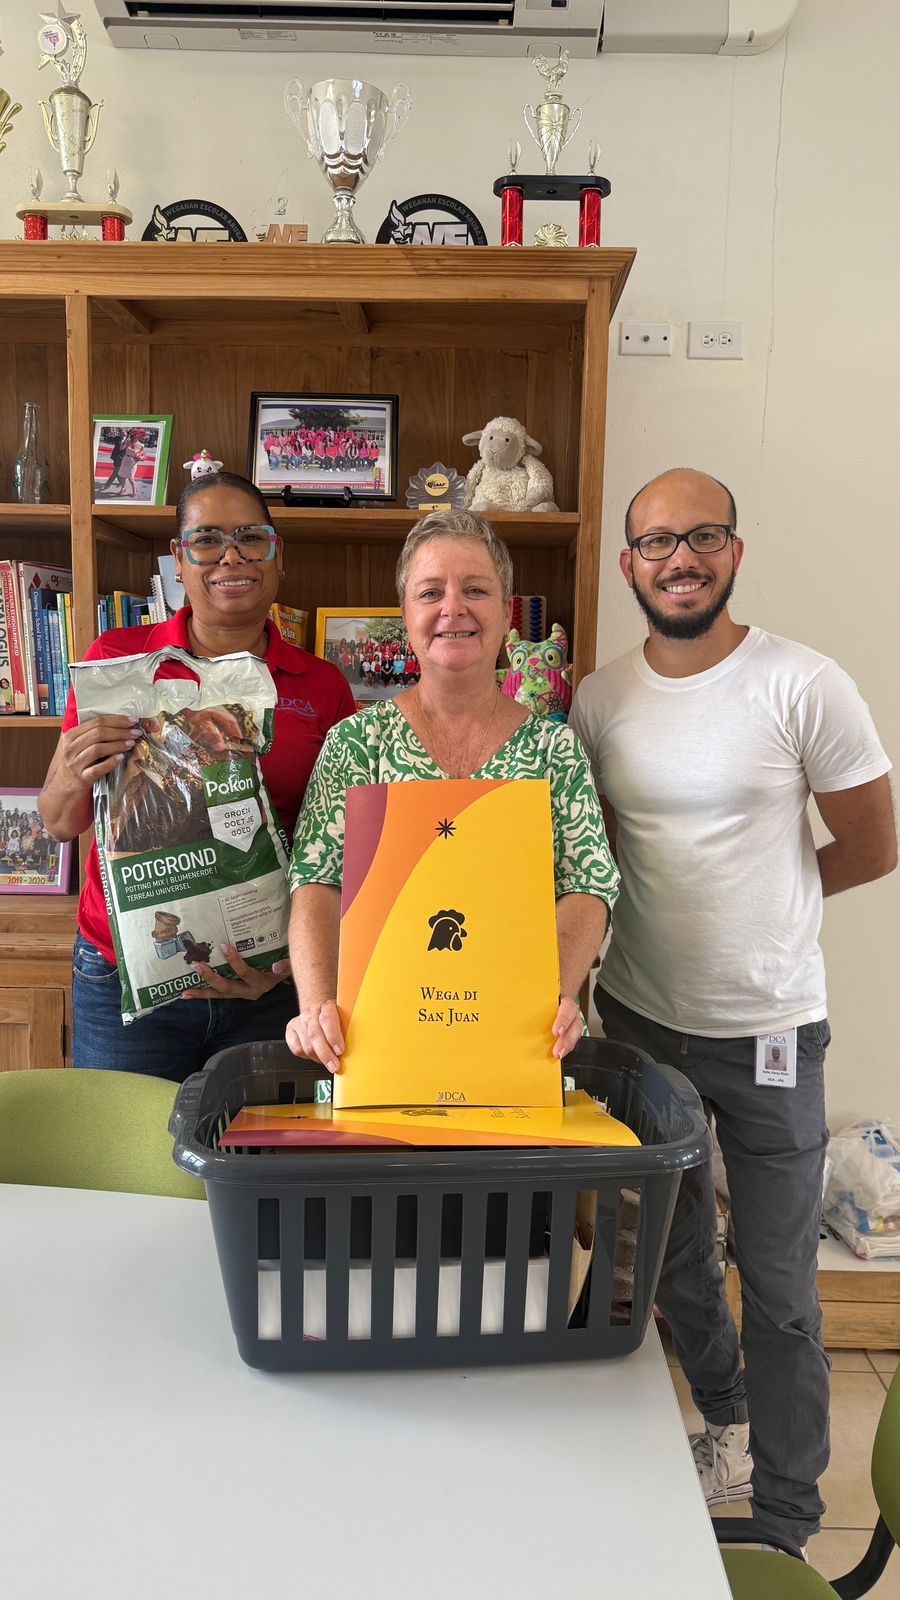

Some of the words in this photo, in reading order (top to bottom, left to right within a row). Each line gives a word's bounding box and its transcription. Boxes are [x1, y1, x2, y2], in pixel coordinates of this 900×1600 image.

[165, 203, 198, 217] WEGANAN
[200, 203, 226, 221] ESCOLAR
[275, 197, 288, 216] 2
[401, 198, 436, 212] WEGANAN
[438, 198, 466, 217] ESCOLAR
[280, 697, 315, 713] DCA
[205, 777, 254, 797] Pokon
[224, 807, 251, 819] GROEN
[224, 818, 245, 829] DOET
[246, 816, 254, 824] JE
[231, 826, 251, 836] GOED
[120, 848, 217, 884] POTGROND
[125, 881, 152, 894] POTTING
[152, 878, 165, 888] MIX
[169, 868, 214, 884] BLUMENERDE
[127, 891, 155, 902] TERREAU
[155, 883, 191, 896] UNIVERSEL
[148, 972, 205, 1000] POTGRO
[444, 1092, 466, 1100] DCA
